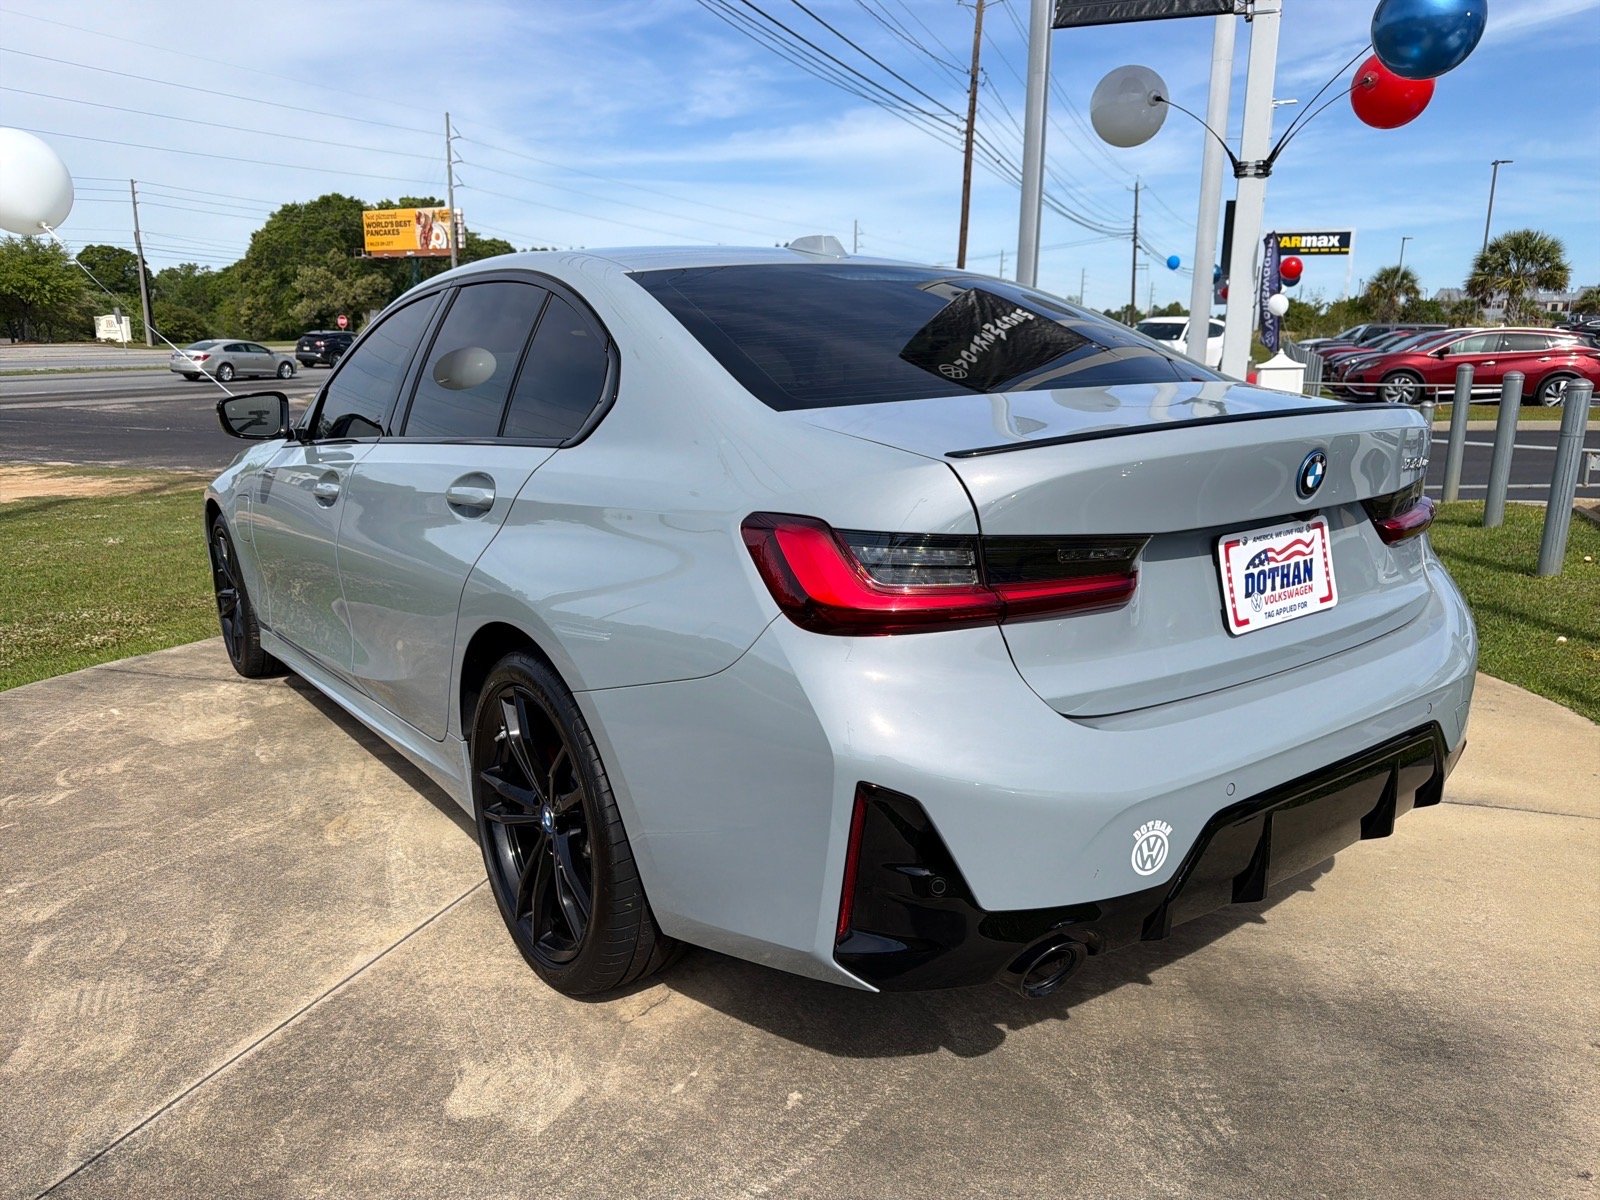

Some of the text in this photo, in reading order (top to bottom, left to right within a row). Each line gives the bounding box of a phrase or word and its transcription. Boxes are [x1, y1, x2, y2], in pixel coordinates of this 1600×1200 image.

[366, 220, 412, 229] WORLD'S BEST
[366, 228, 400, 237] PANCAKES
[1277, 235, 1341, 248] ARmax
[1283, 528, 1294, 537] LOVE
[1244, 558, 1314, 599] DOTHAN
[1264, 584, 1314, 606] VOLKSWAGEN
[1264, 609, 1275, 620] TAG
[1275, 604, 1297, 617] APPLIED
[1297, 601, 1308, 611] FOR
[1132, 819, 1173, 840] DOTHAN
